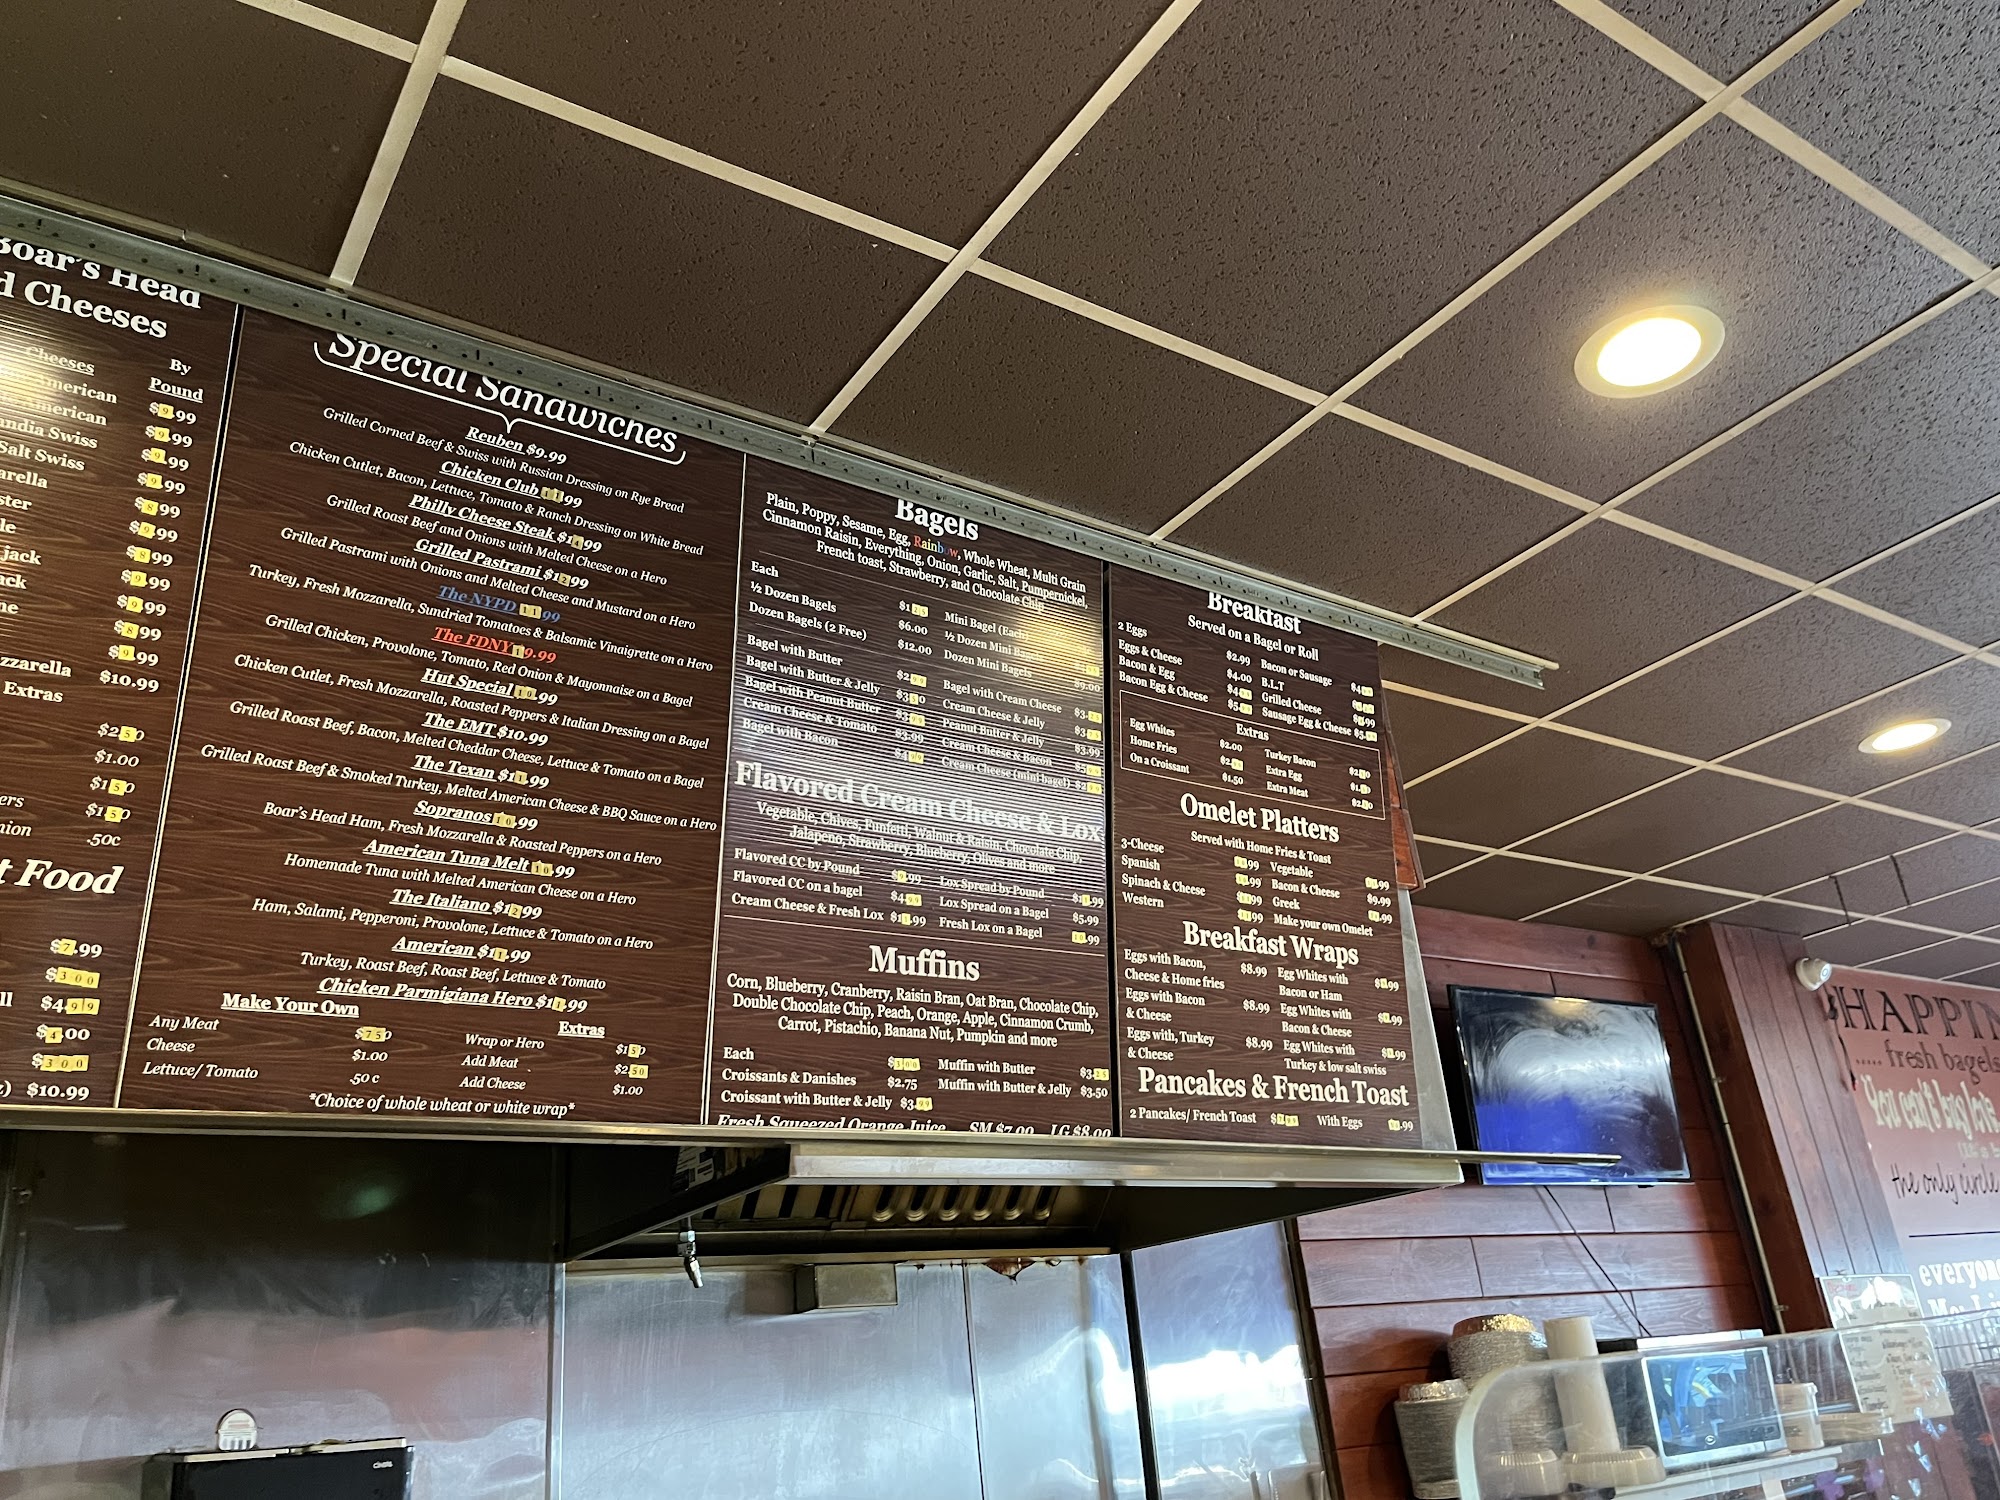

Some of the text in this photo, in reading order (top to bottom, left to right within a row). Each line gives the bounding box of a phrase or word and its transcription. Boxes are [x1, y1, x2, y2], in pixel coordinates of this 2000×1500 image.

[24, 281, 168, 338] Cheeses
[169, 359, 191, 375] By
[148, 377, 203, 400] Pound
[328, 334, 677, 452] Special Sandwiches
[34, 448, 85, 471] Swiss
[465, 426, 566, 464] Reuben $9.99
[324, 408, 684, 513] Grilled Corned Beef & Swiss with Russian Dressing on Rye Bread
[439, 462, 543, 496] Chicken Club
[408, 494, 556, 542] Philly Cheese Steak
[895, 499, 978, 541] Bagels
[766, 494, 1086, 592] Plain, Poppy, Sesame, Egg, Rainbow, Whole Wheat, Multi Grain
[414, 539, 542, 580] Grilled Pastrami
[751, 562, 778, 577] Each
[440, 586, 520, 614] The NYPD
[765, 585, 799, 603] Dozen
[802, 595, 836, 612] Bagels
[899, 620, 928, 635] $6.00
[1208, 592, 1301, 634] Breakfast
[431, 627, 462, 645] The
[460, 634, 511, 656] FDNY
[749, 602, 932, 655] Dozen Bagels (2 Free) $12.00
[1188, 615, 1318, 661] Served on a Bagel or Roll
[1118, 622, 1250, 666] 2 Eggs $2.99
[100, 670, 158, 692] $10.99
[420, 668, 450, 686] Hut
[446, 674, 514, 699] Special
[1261, 659, 1332, 686] Bacon or Sausage
[3, 681, 63, 702] Extras
[424, 712, 548, 746] The EMT $10.99
[1236, 723, 1269, 740] Extras
[94, 749, 139, 766] $1.00
[414, 755, 444, 771] The
[448, 760, 494, 781] Texan
[1130, 753, 1142, 763] On
[1150, 757, 1190, 774] Croissant
[413, 800, 491, 825] Sopranos
[1181, 793, 1339, 842] Omelet Platters
[87, 834, 120, 846] .50c
[363, 840, 446, 861] American
[450, 850, 490, 866] Tuna
[492, 855, 528, 872] Melt
[14, 859, 124, 893] Food
[1122, 873, 1205, 896] Spinach & Cheese
[390, 889, 491, 912] The Italiano
[392, 936, 473, 957] American
[1183, 921, 1358, 969] Breakfast Wraps
[868, 945, 979, 981] Muffins
[1124, 949, 1267, 977] Eggs with Bacon, $8.99
[221, 993, 359, 1015] Make Your Own
[319, 978, 390, 997] Chicken
[390, 984, 502, 1006] Parmigiana
[496, 992, 532, 1009] Hero
[727, 974, 1098, 1018] Corn, Blueberry, Cranberry, Raisin Bran, Oat Bran, Chocolate Chip,
[149, 1015, 219, 1031] Any Meat
[558, 1021, 605, 1037] Extras
[1884, 1039, 1939, 1070] fresh
[27, 1082, 89, 1100] $10.99
[1138, 1067, 1409, 1106] Pancakes & French Toast
[367, 1095, 385, 1111] of
[385, 1096, 427, 1110] whole
[430, 1098, 472, 1112] wheat
[475, 1102, 491, 1112] or
[494, 1100, 530, 1114] white
[1317, 1115, 1362, 1130] With Eggs
